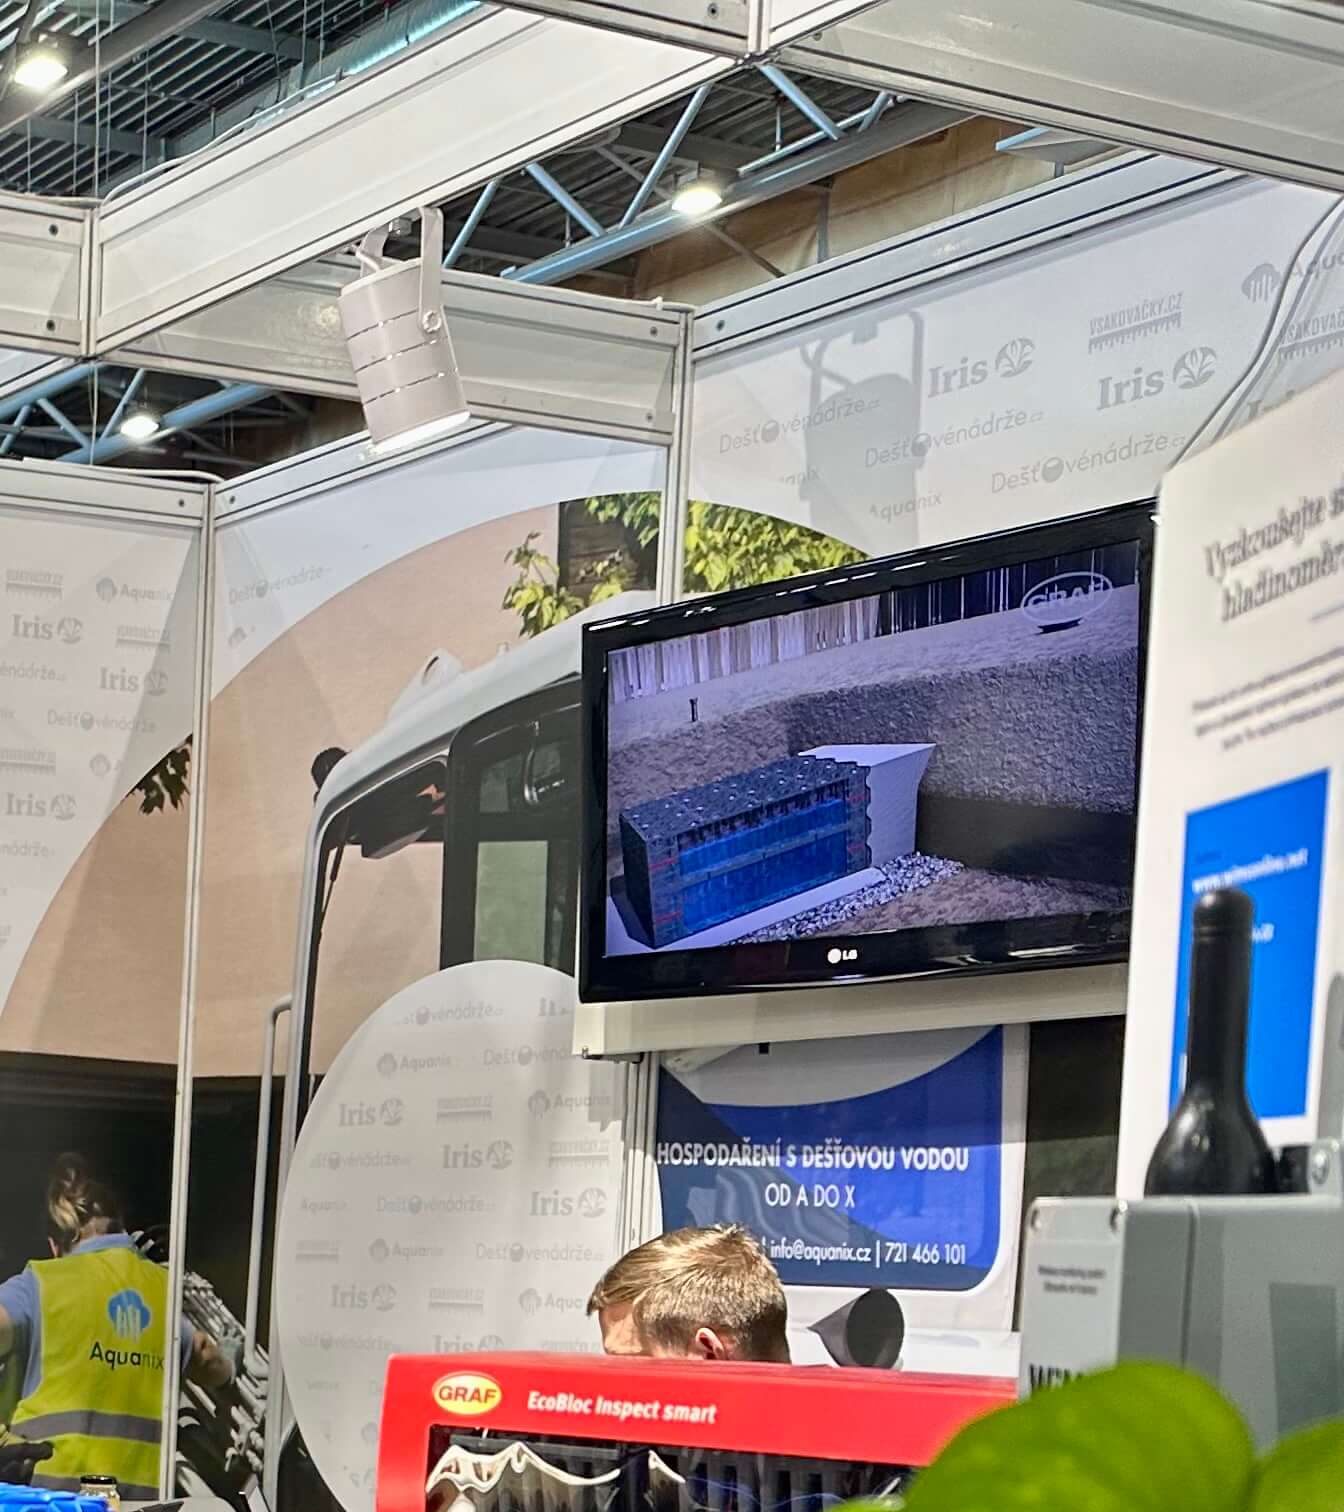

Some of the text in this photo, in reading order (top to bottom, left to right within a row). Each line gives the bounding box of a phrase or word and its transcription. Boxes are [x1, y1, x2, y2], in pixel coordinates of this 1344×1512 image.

[1090, 292, 1183, 336] VSAKOVAČKY.CZ
[928, 358, 989, 398] Iris
[1096, 368, 1164, 414] Iris
[12, 613, 53, 640] Iris
[98, 667, 139, 692] Iris
[4, 791, 47, 817] Iris
[842, 948, 858, 961] LG
[337, 1103, 376, 1127] Iris
[442, 1144, 483, 1169] Iris
[656, 1137, 969, 1171] HOSPODAŘENÍ S DEŠŤOVOU VODOU
[529, 1190, 574, 1217] Iris
[765, 1182, 856, 1208] OD A DO X
[770, 1239, 967, 1267] info@aquanix.cz 721 466 101
[331, 1284, 369, 1310] Iris
[89, 1341, 164, 1371] Aquanix
[438, 1384, 498, 1406] GRAF
[527, 1390, 717, 1425] EcoBloc Inspect smart
